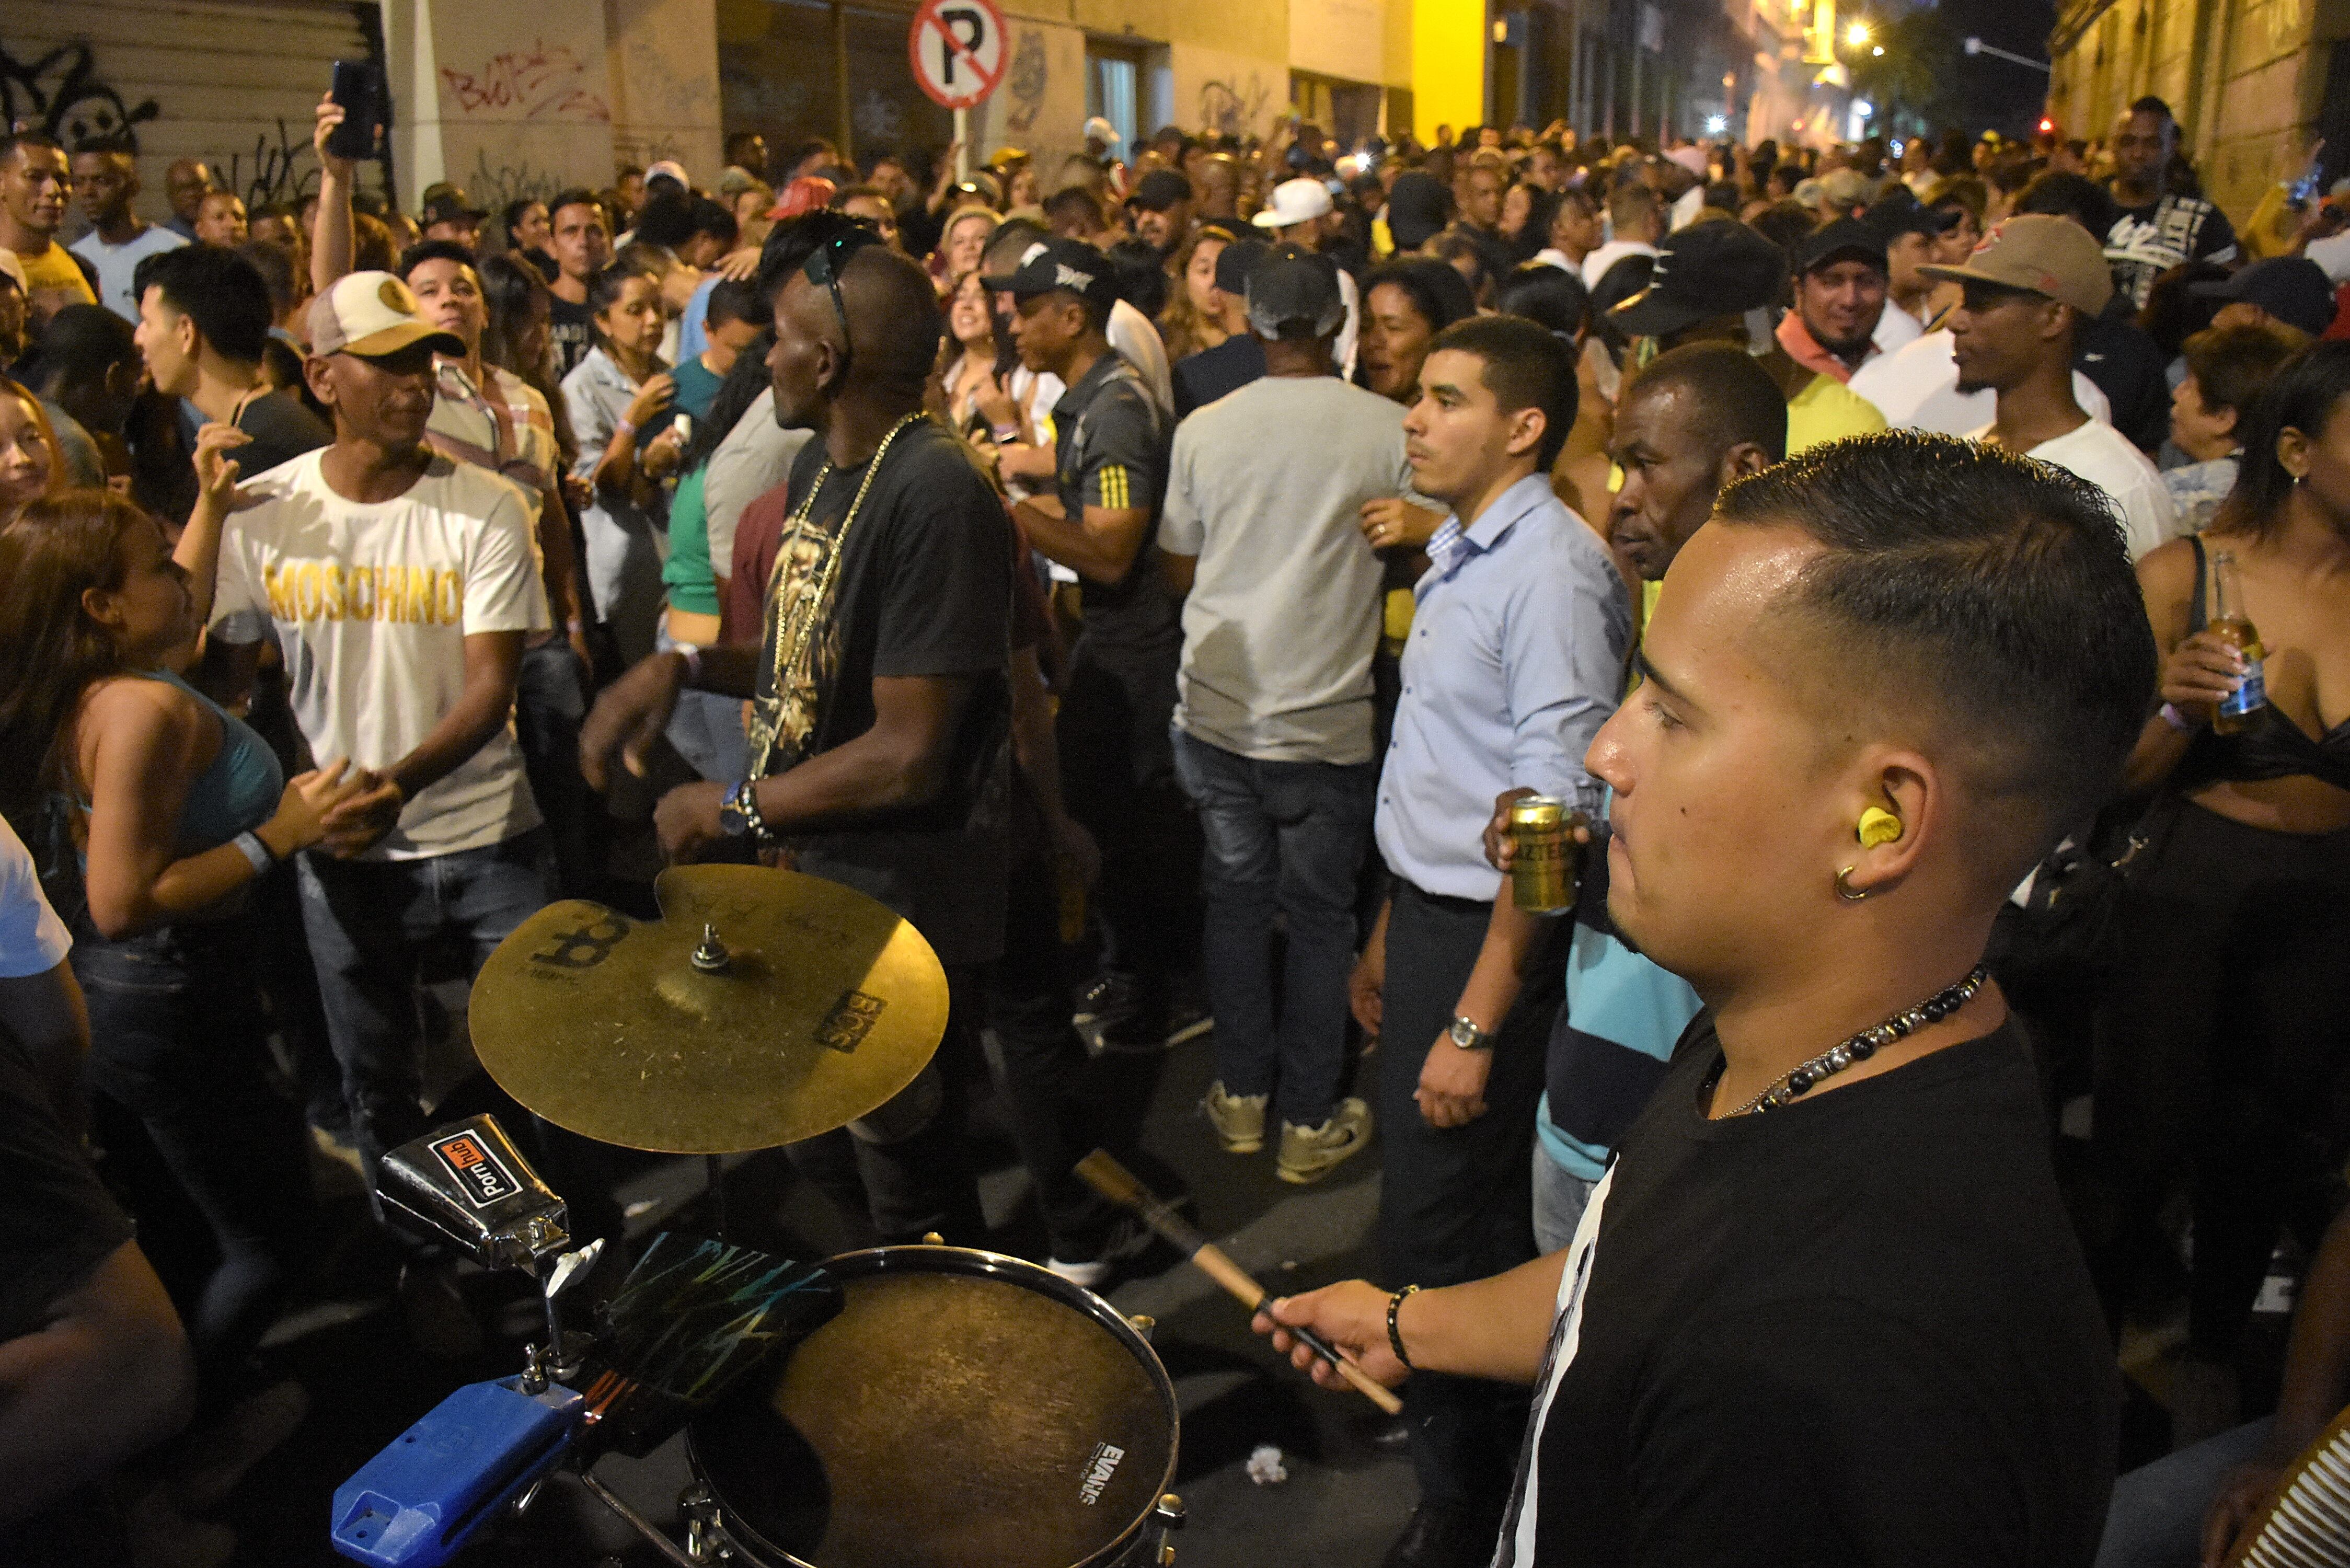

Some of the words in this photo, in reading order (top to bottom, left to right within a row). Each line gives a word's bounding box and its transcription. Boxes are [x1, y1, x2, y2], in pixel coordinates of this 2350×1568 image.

[942, 9, 983, 84] P
[264, 563, 463, 626] MOSCHINO
[1079, 1444, 1125, 1506] EVANS
